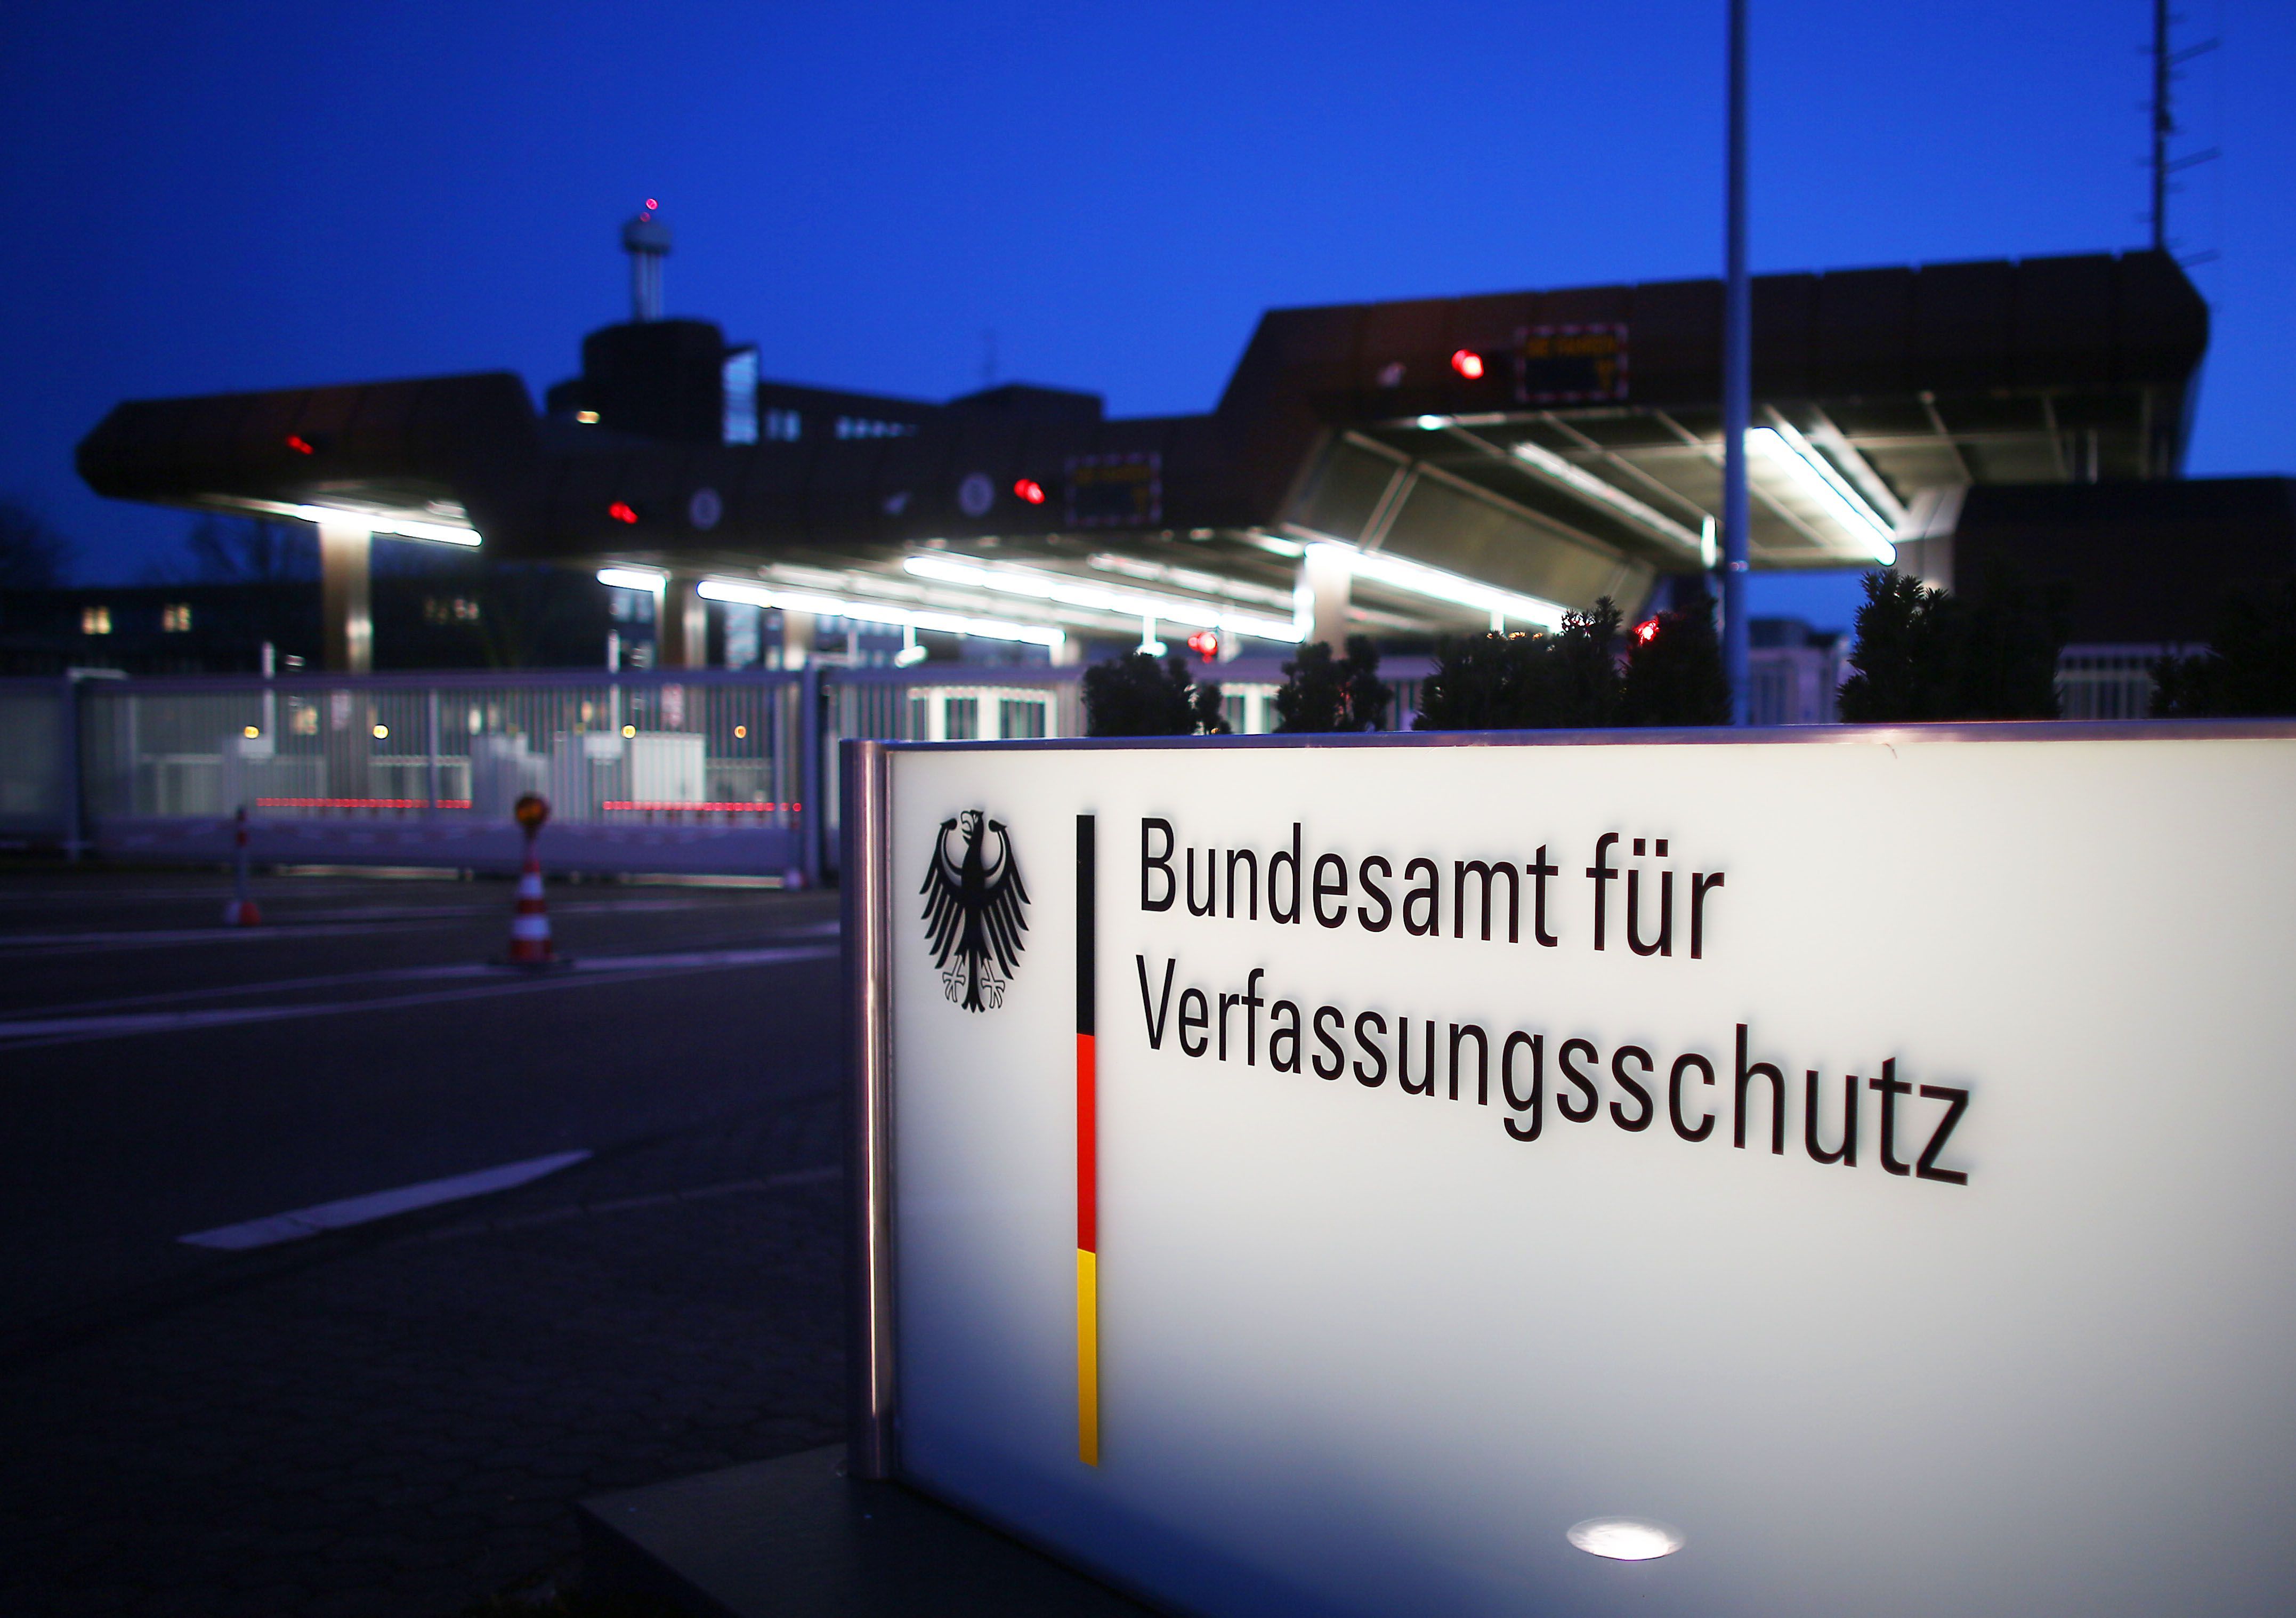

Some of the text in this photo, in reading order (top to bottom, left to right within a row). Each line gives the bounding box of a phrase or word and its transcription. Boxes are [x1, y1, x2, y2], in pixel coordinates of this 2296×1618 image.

[1141, 817, 1726, 960] Bundesamt für
[1135, 954, 1969, 1186] Verfassungsschutz
